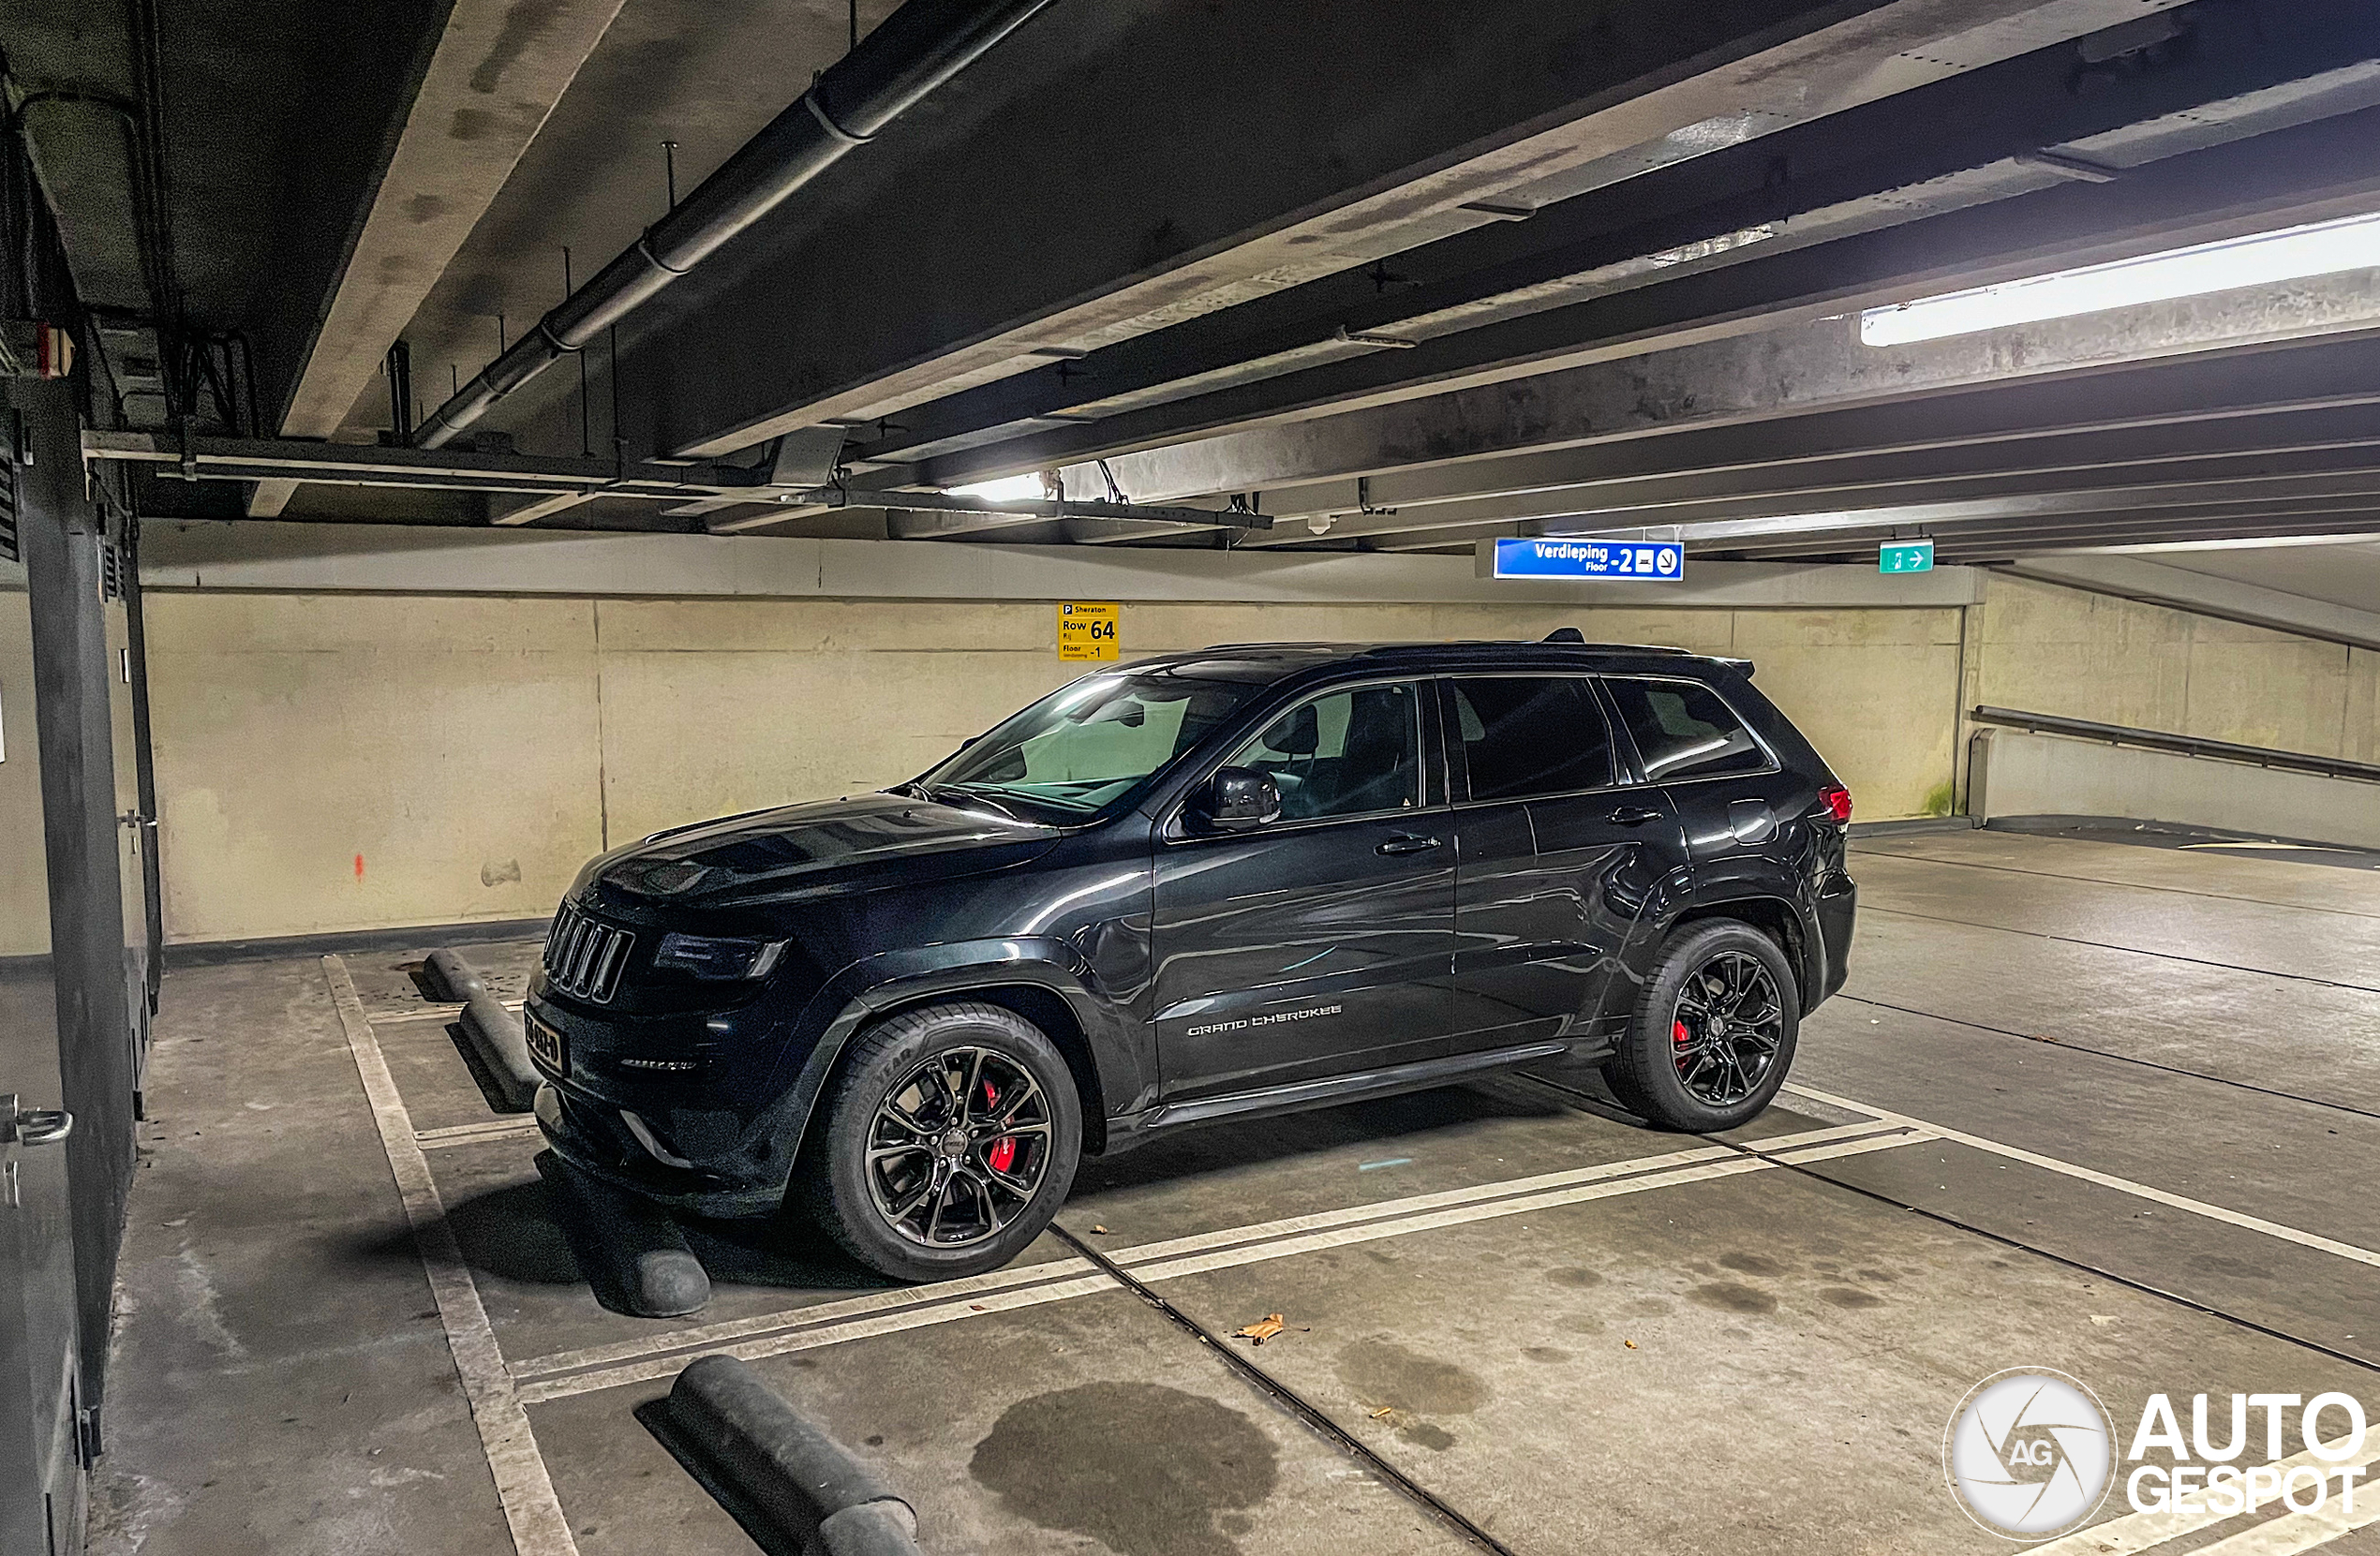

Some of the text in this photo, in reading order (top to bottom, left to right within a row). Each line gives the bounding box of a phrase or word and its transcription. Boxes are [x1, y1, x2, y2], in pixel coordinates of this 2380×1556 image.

[1535, 543, 1608, 562] Verdieping
[1611, 549, 1632, 572] -2
[1585, 562, 1608, 571] Floor
[1064, 621, 1115, 639] Row 64
[1091, 646, 1100, 658] -1
[1186, 1004, 1342, 1036] GRAND CHEROKEE
